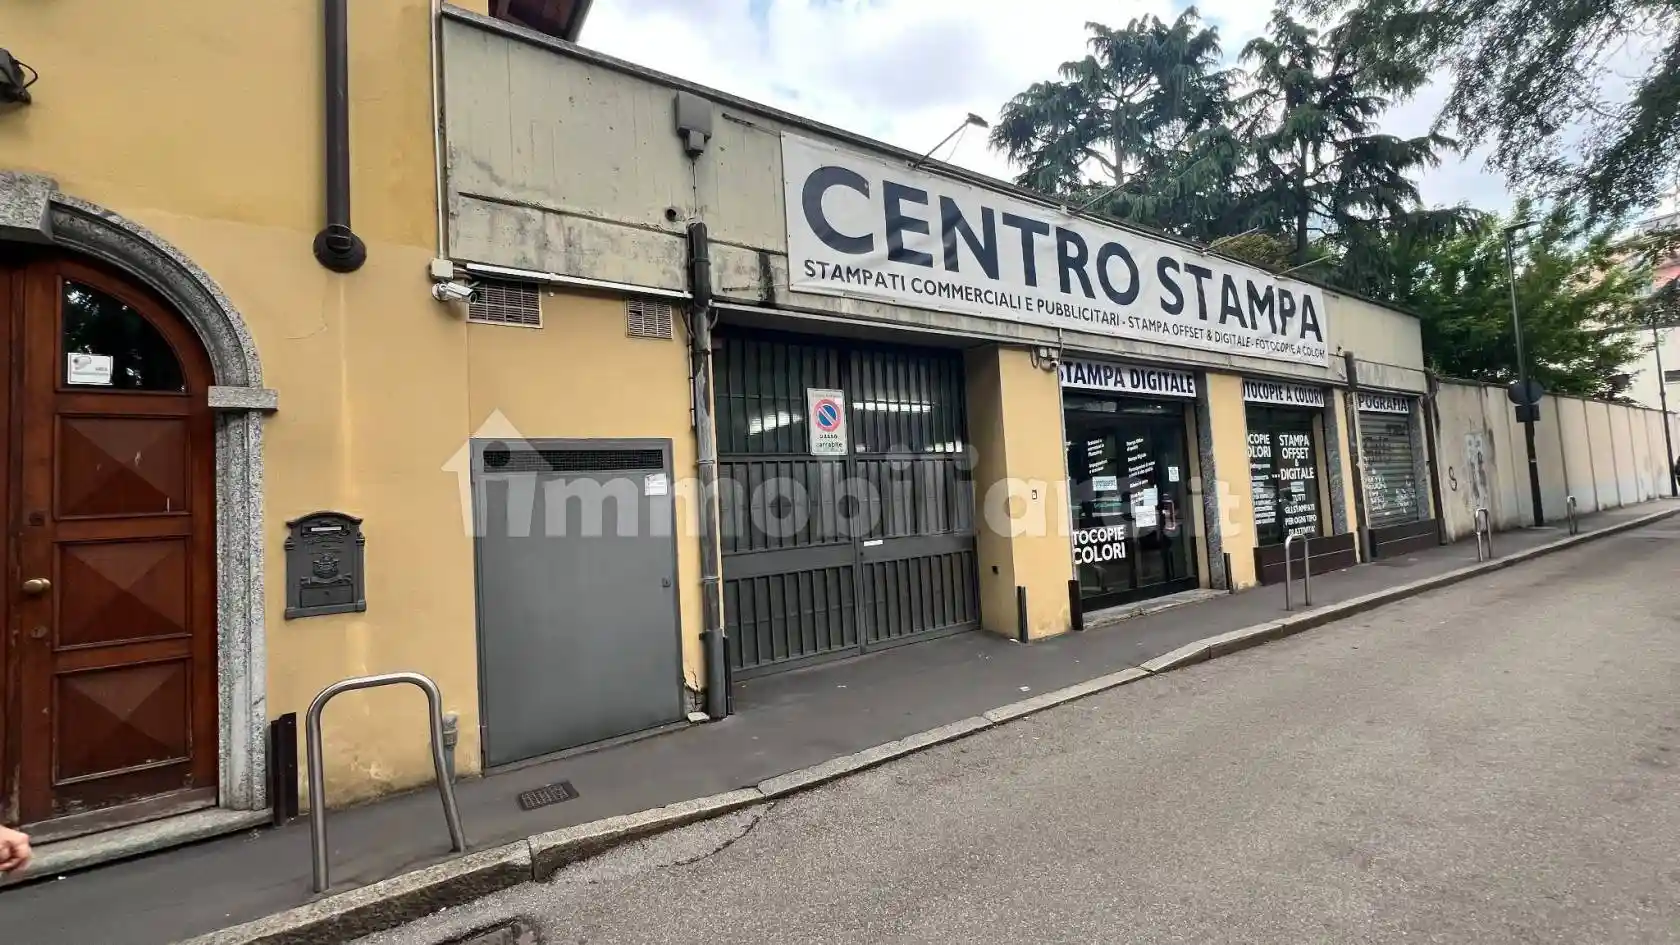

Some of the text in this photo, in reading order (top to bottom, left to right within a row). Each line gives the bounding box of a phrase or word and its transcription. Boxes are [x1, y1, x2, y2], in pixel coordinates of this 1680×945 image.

[801, 165, 1323, 343] CENTRO STAMPA
[804, 259, 906, 292] STAMPATI
[910, 277, 1022, 310] COMMERCIALI
[1026, 297, 1035, 312] E
[1037, 299, 1120, 326] PUBBLICITARI
[1128, 316, 1170, 335] STAMPA
[1172, 323, 1204, 340] OFFSET
[1206, 329, 1213, 341] &
[1214, 332, 1251, 348] DIGITALE
[1128, 368, 1195, 394] DIGITALE
[1286, 385, 1293, 402] A
[1294, 386, 1323, 405] COLORI
[1279, 434, 1310, 447] STAMPA
[1281, 447, 1309, 460] OFFSET
[1073, 541, 1126, 565] COLORI
